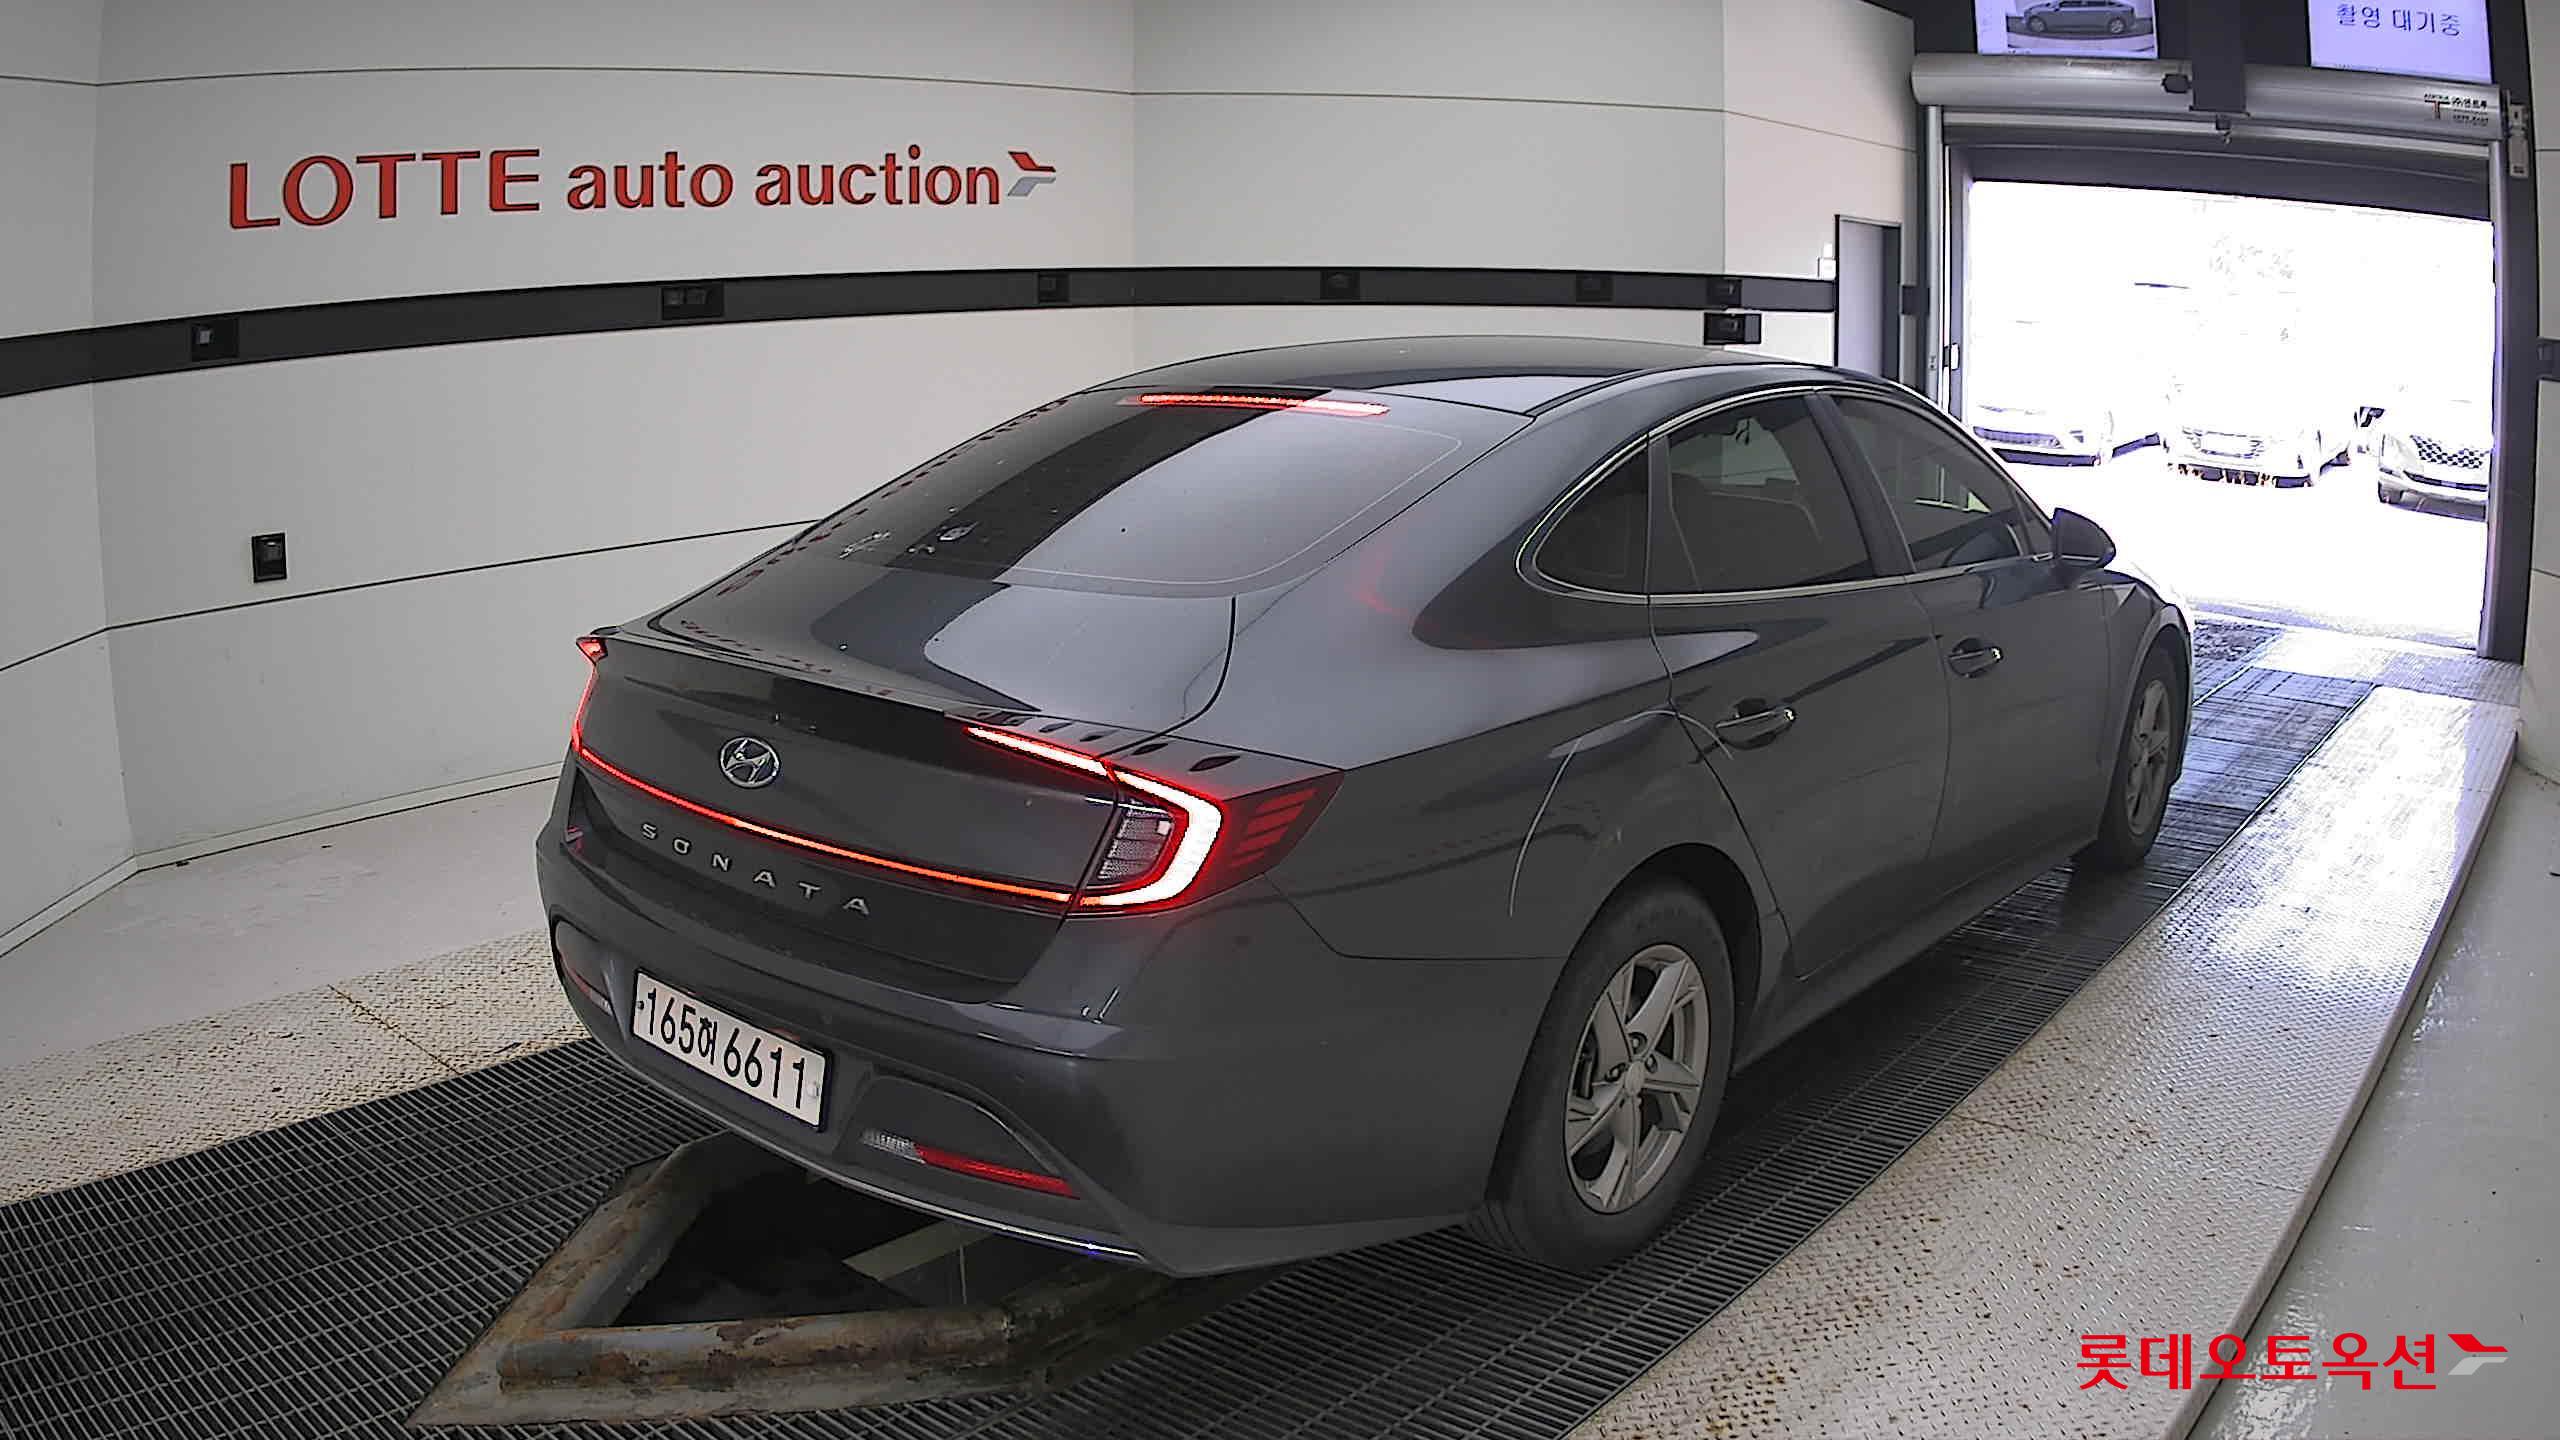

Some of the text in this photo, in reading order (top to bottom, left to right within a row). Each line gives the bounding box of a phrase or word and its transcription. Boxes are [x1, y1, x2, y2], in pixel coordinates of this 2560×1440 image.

[2337, 4, 2381, 28] 촬영
[228, 145, 1001, 230] LOTTE auto auction
[641, 823, 869, 915] SONATA
